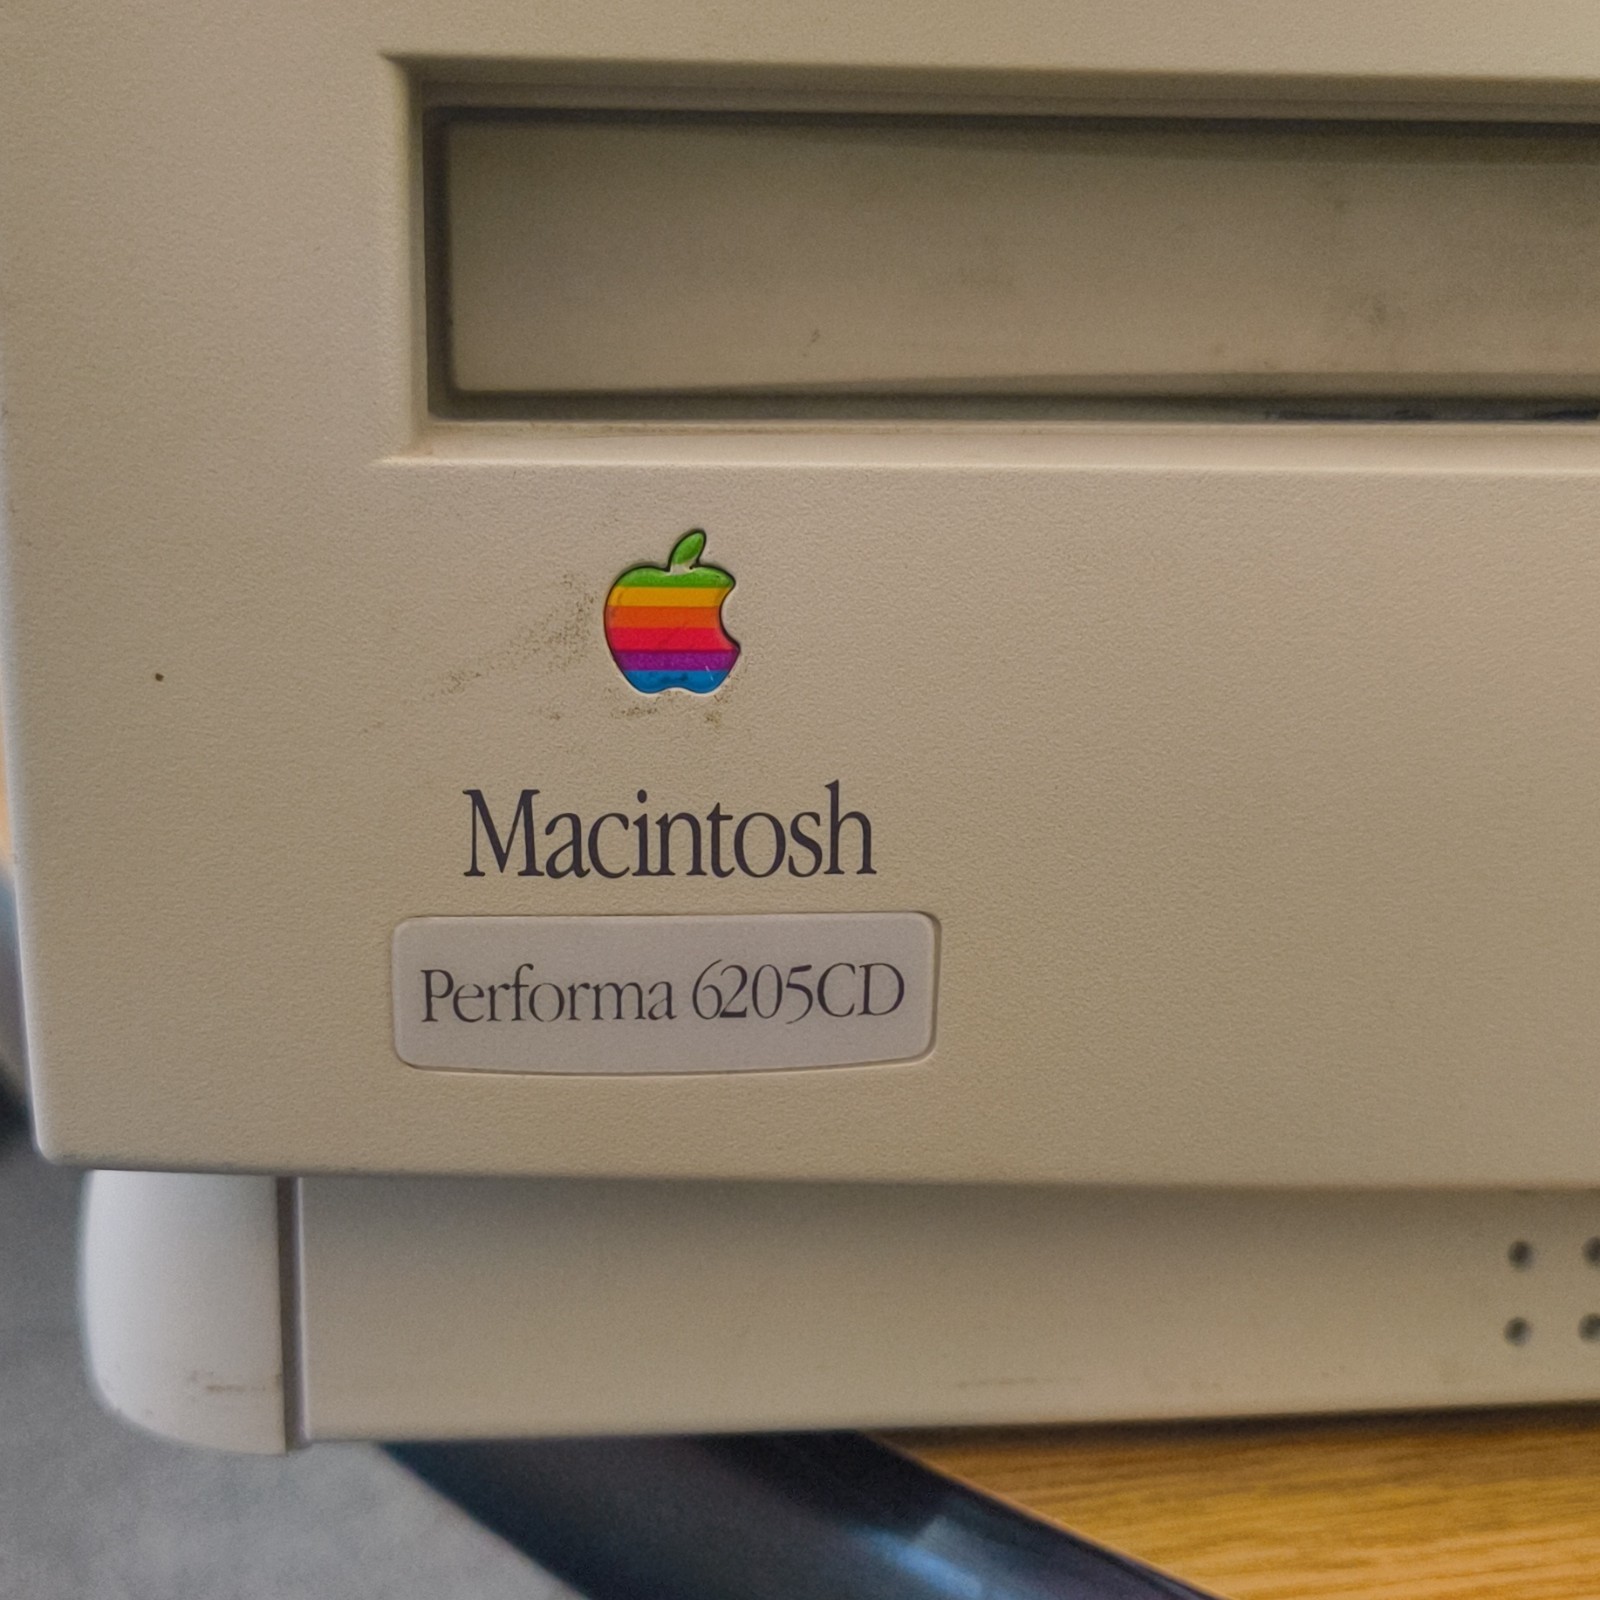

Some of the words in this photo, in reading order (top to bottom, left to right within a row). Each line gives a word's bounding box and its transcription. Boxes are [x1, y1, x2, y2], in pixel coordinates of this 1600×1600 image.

[462, 779, 878, 880] Macintosh
[420, 963, 678, 1023] Performa
[691, 958, 906, 1024] 6205CD
